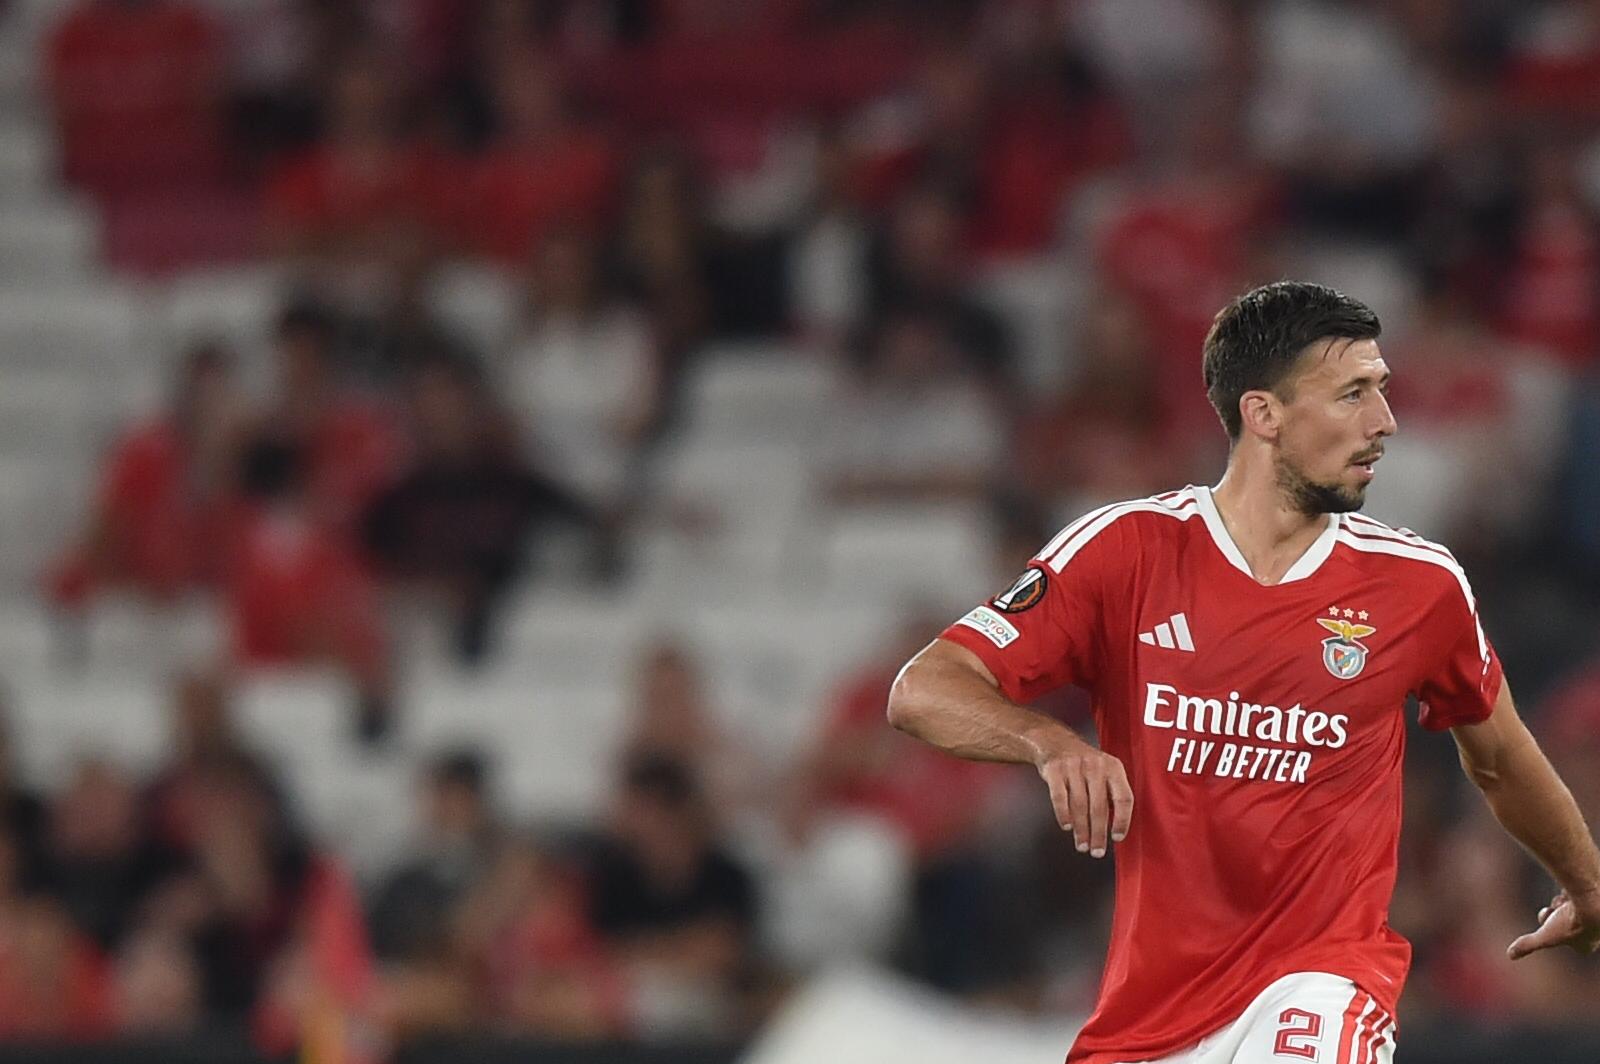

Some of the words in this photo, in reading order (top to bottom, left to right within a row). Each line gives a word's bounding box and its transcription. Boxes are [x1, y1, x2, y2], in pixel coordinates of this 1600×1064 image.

[1143, 682, 1349, 749] Emirates
[1166, 737, 1215, 776] FLY
[1214, 742, 1312, 784] BETTER
[1273, 1007, 1323, 1062] 2
